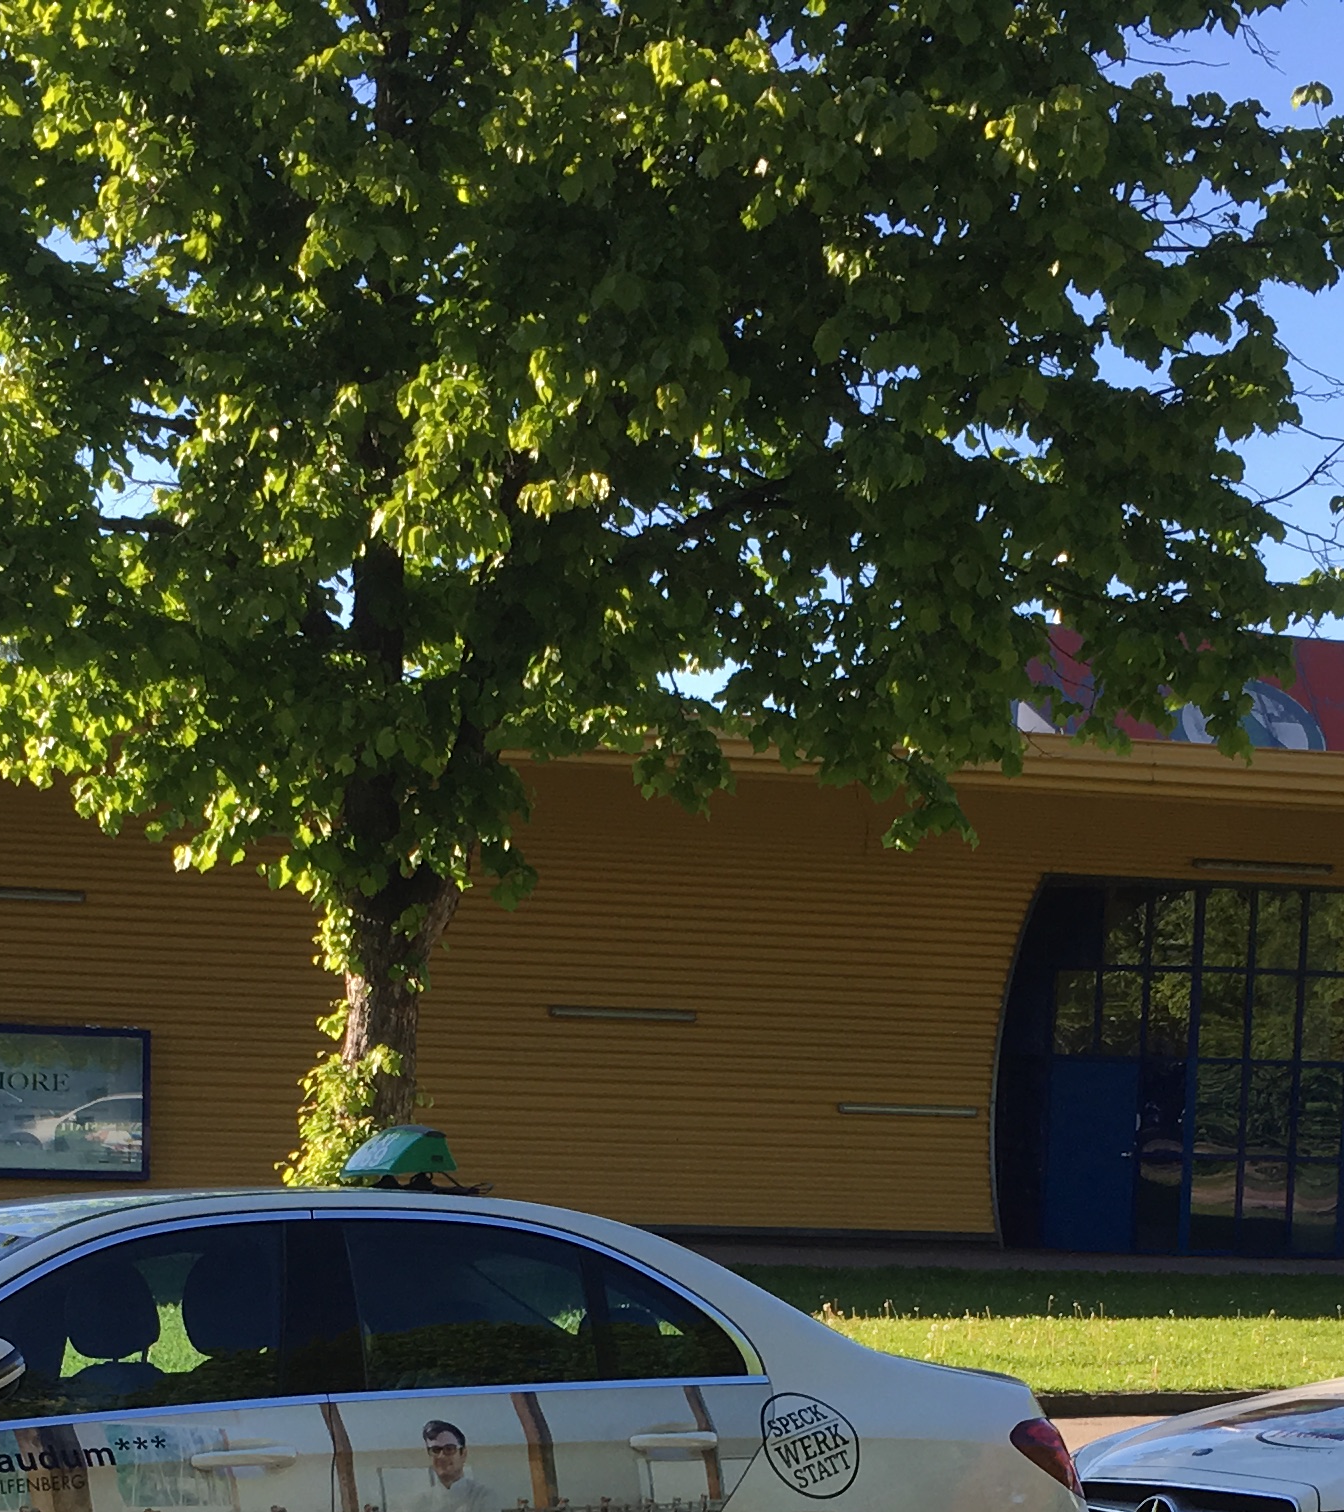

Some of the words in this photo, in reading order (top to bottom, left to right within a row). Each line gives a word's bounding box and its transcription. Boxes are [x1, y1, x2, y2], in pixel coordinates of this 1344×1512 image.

[767, 1404, 828, 1438] SPECK
[774, 1423, 850, 1469] WERK
[794, 1449, 851, 1488] STATT
